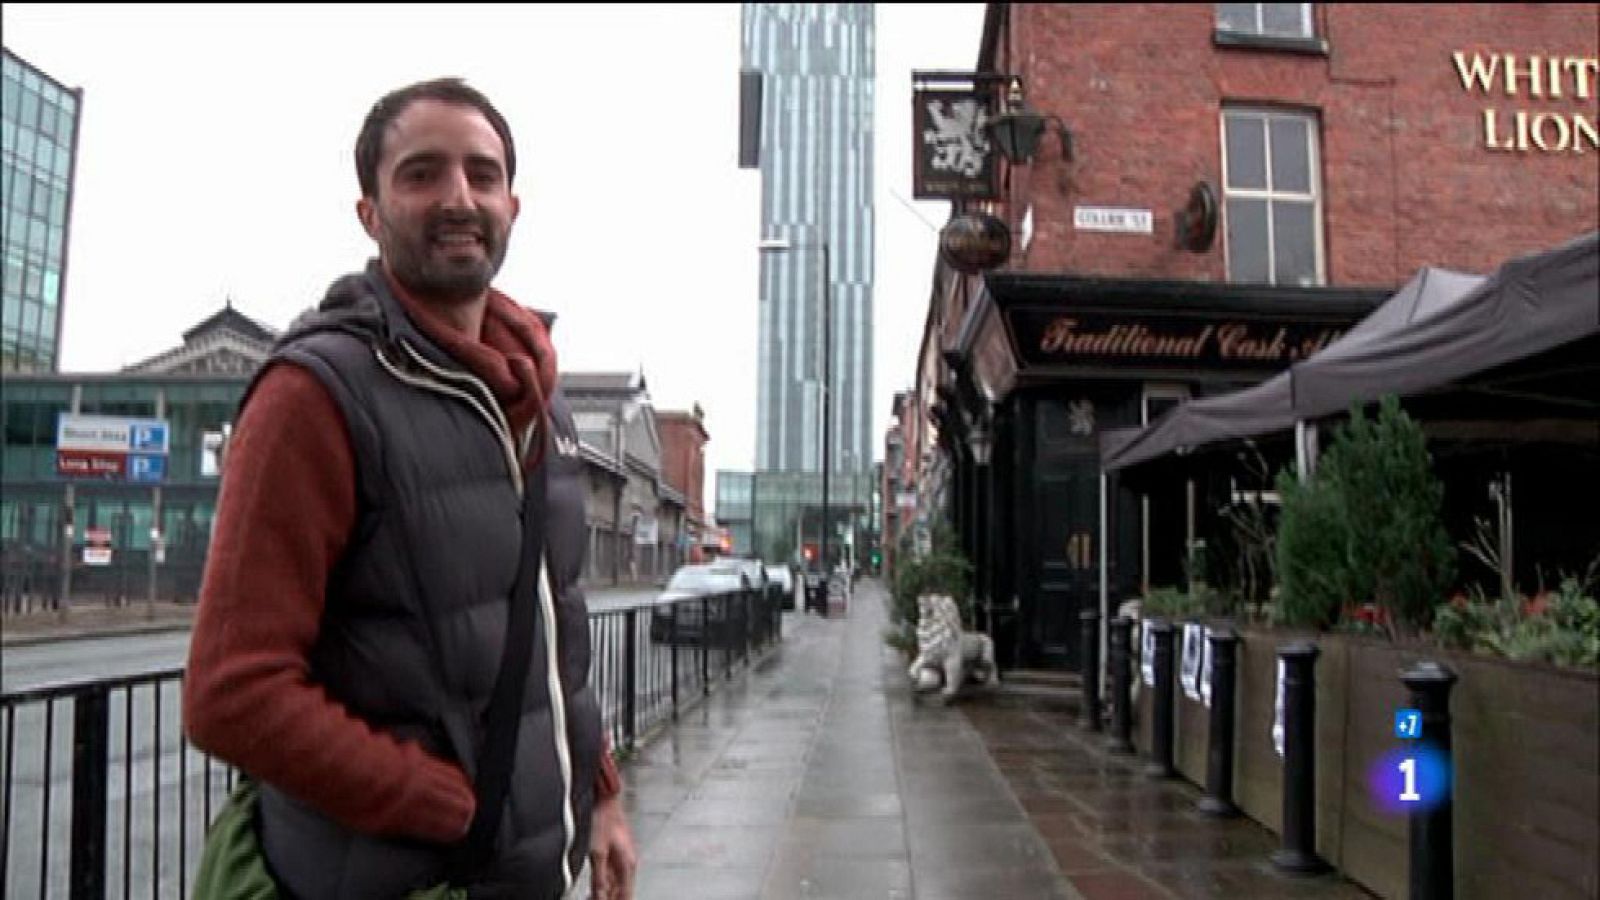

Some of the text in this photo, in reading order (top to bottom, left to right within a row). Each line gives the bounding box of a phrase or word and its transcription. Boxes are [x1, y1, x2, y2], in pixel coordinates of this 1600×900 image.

[1452, 50, 1599, 99] WHIT
[1483, 108, 1600, 154] LION
[1040, 317, 1213, 357] Traditional
[1217, 323, 1286, 360] Cask
